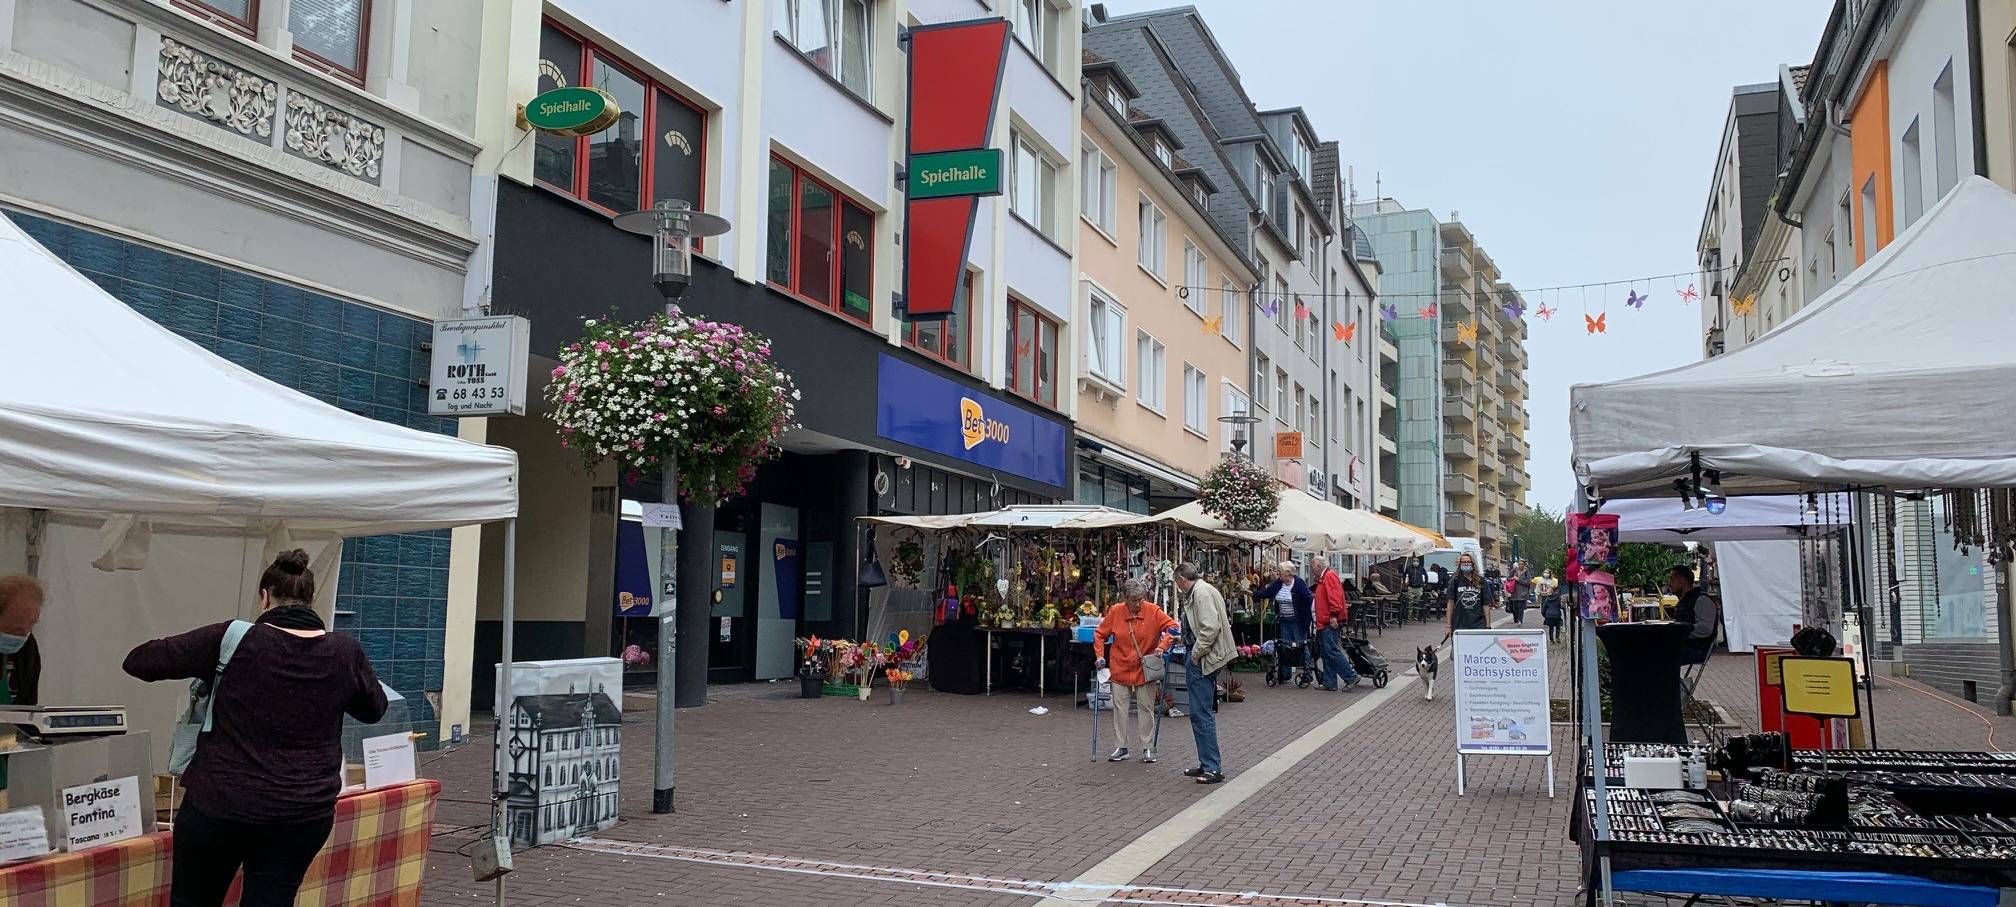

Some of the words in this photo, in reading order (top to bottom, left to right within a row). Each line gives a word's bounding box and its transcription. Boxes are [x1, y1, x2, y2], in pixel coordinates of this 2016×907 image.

[540, 100, 592, 117] Spielhalle
[920, 166, 986, 187] Spielhalle
[439, 321, 507, 334] Beerdigungsinstitut
[447, 364, 486, 378] ROTH
[453, 388, 467, 400] 68
[472, 388, 486, 399] 43
[490, 387, 504, 398] 53
[448, 403, 458, 411] Tag
[474, 401, 493, 409] Nacht
[1464, 666, 1538, 679] Dachsysteme
[66, 787, 120, 806] Bergkäse
[70, 808, 116, 826] Fontina
[70, 834, 100, 845] Toscana
